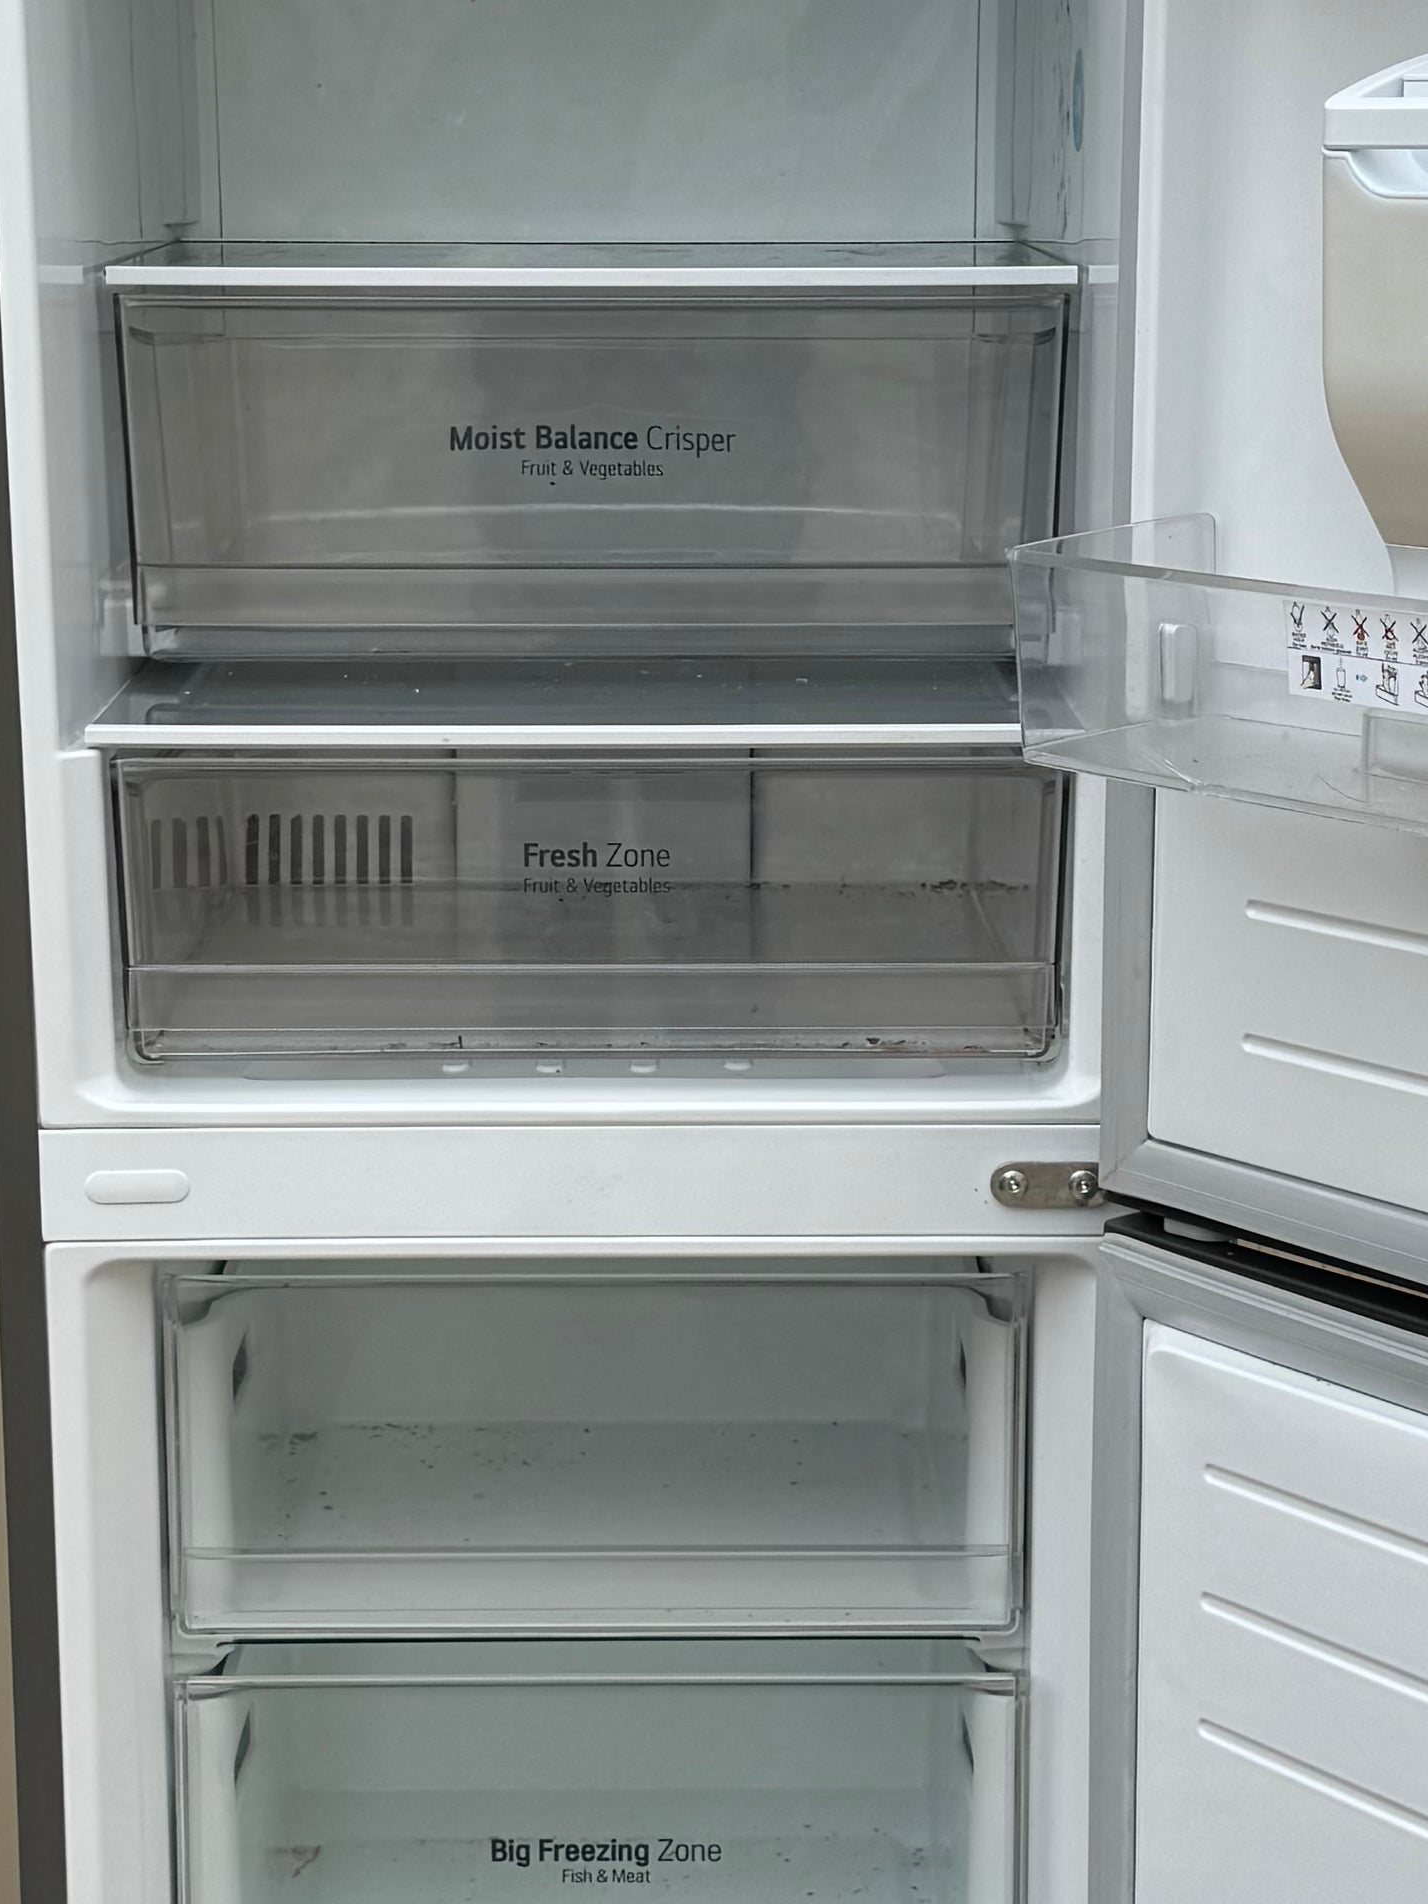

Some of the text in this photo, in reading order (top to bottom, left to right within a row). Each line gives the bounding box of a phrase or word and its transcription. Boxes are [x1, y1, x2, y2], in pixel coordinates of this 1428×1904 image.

[450, 426, 736, 458] Moist Balance Crisper
[522, 460, 664, 480] Fruit & Vegetables
[524, 843, 670, 867] Fresh Zone
[524, 878, 670, 897] Fruit & Vegetables
[491, 1839, 722, 1867] Big Freezing Zone
[562, 1869, 651, 1883] Fish & Meat
